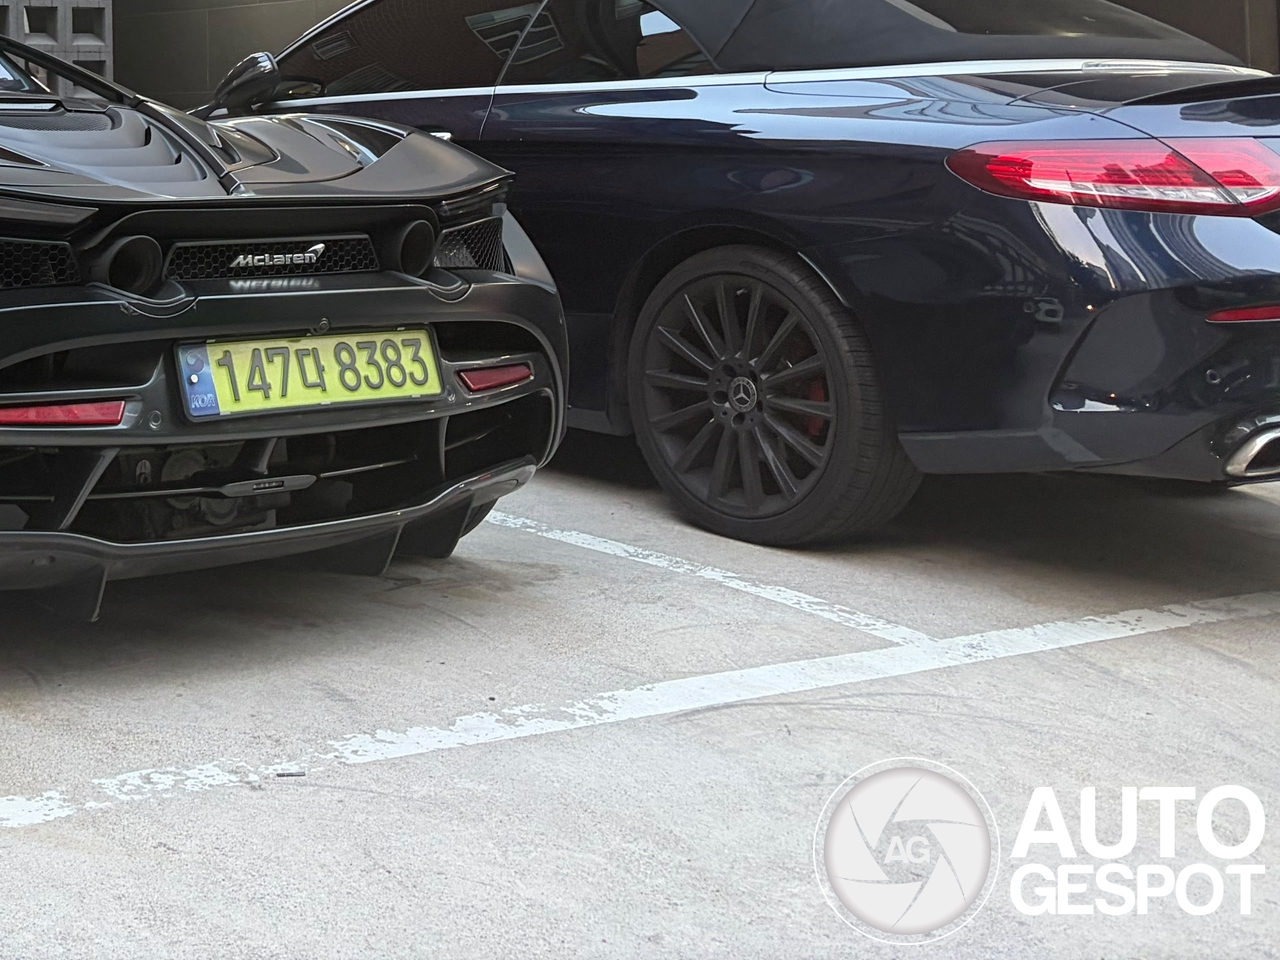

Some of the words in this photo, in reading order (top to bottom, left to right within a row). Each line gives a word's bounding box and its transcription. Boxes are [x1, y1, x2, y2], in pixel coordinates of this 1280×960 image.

[229, 253, 317, 268] McLaren
[217, 346, 327, 402] 147다
[333, 338, 429, 391] 8383
[190, 393, 216, 408] KOR
